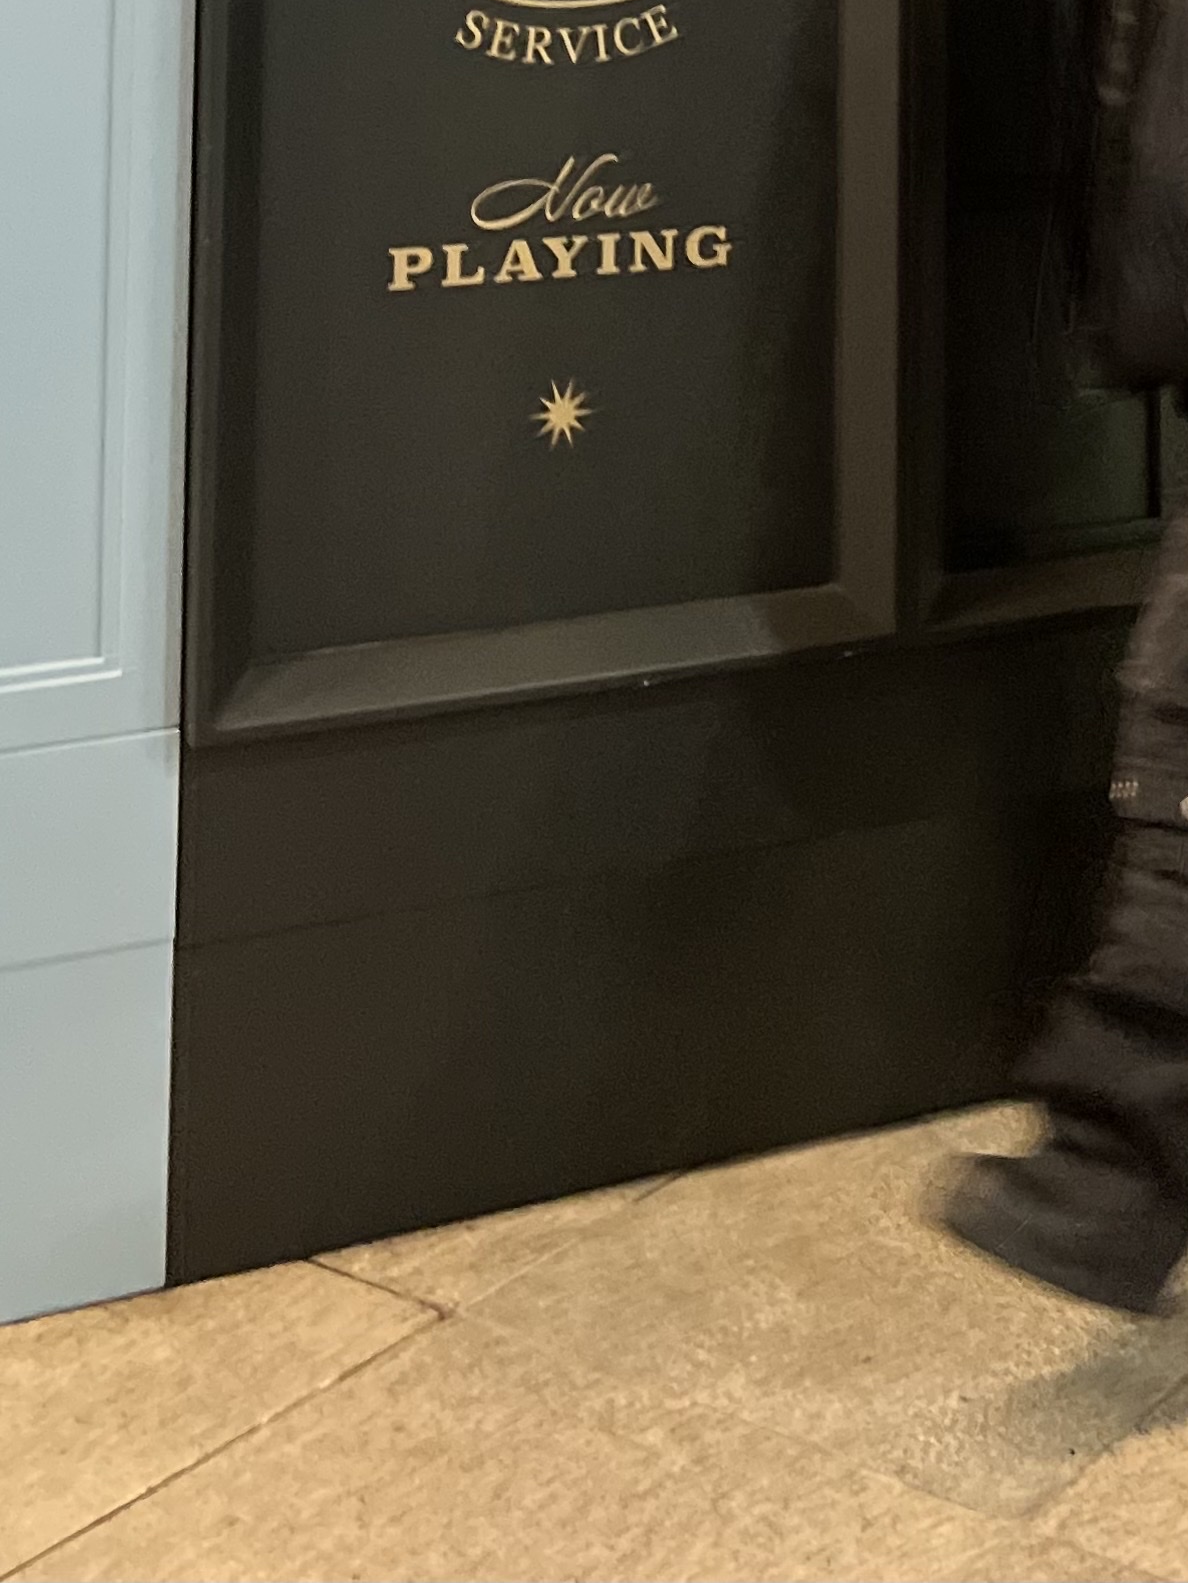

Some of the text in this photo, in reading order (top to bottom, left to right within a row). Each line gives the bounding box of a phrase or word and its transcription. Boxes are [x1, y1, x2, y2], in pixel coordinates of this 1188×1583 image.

[454, 3, 680, 65] SERVICE
[470, 152, 659, 231] Now
[387, 225, 733, 292] PLAYING
